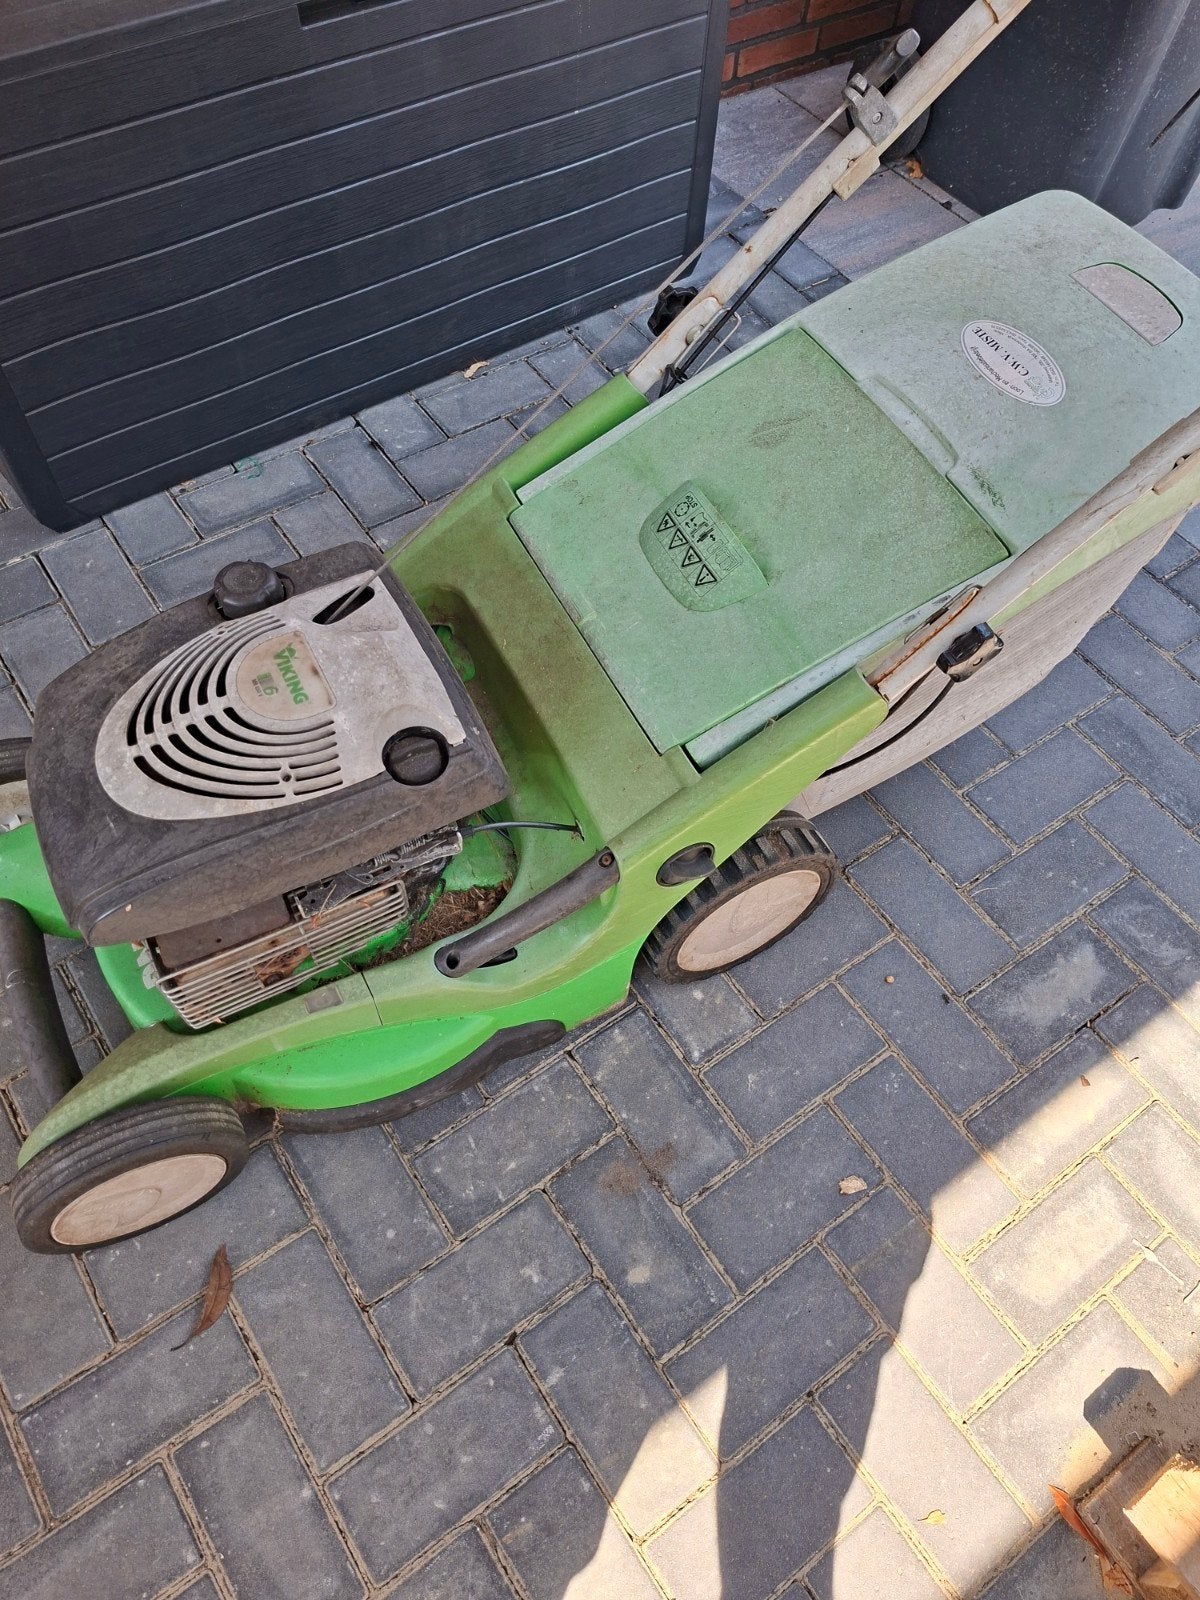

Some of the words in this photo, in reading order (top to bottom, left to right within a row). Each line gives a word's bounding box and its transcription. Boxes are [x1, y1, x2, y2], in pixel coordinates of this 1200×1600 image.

[972, 326, 1002, 352] MISTE
[685, 495, 698, 508] STOP
[274, 643, 309, 704] VIKING
